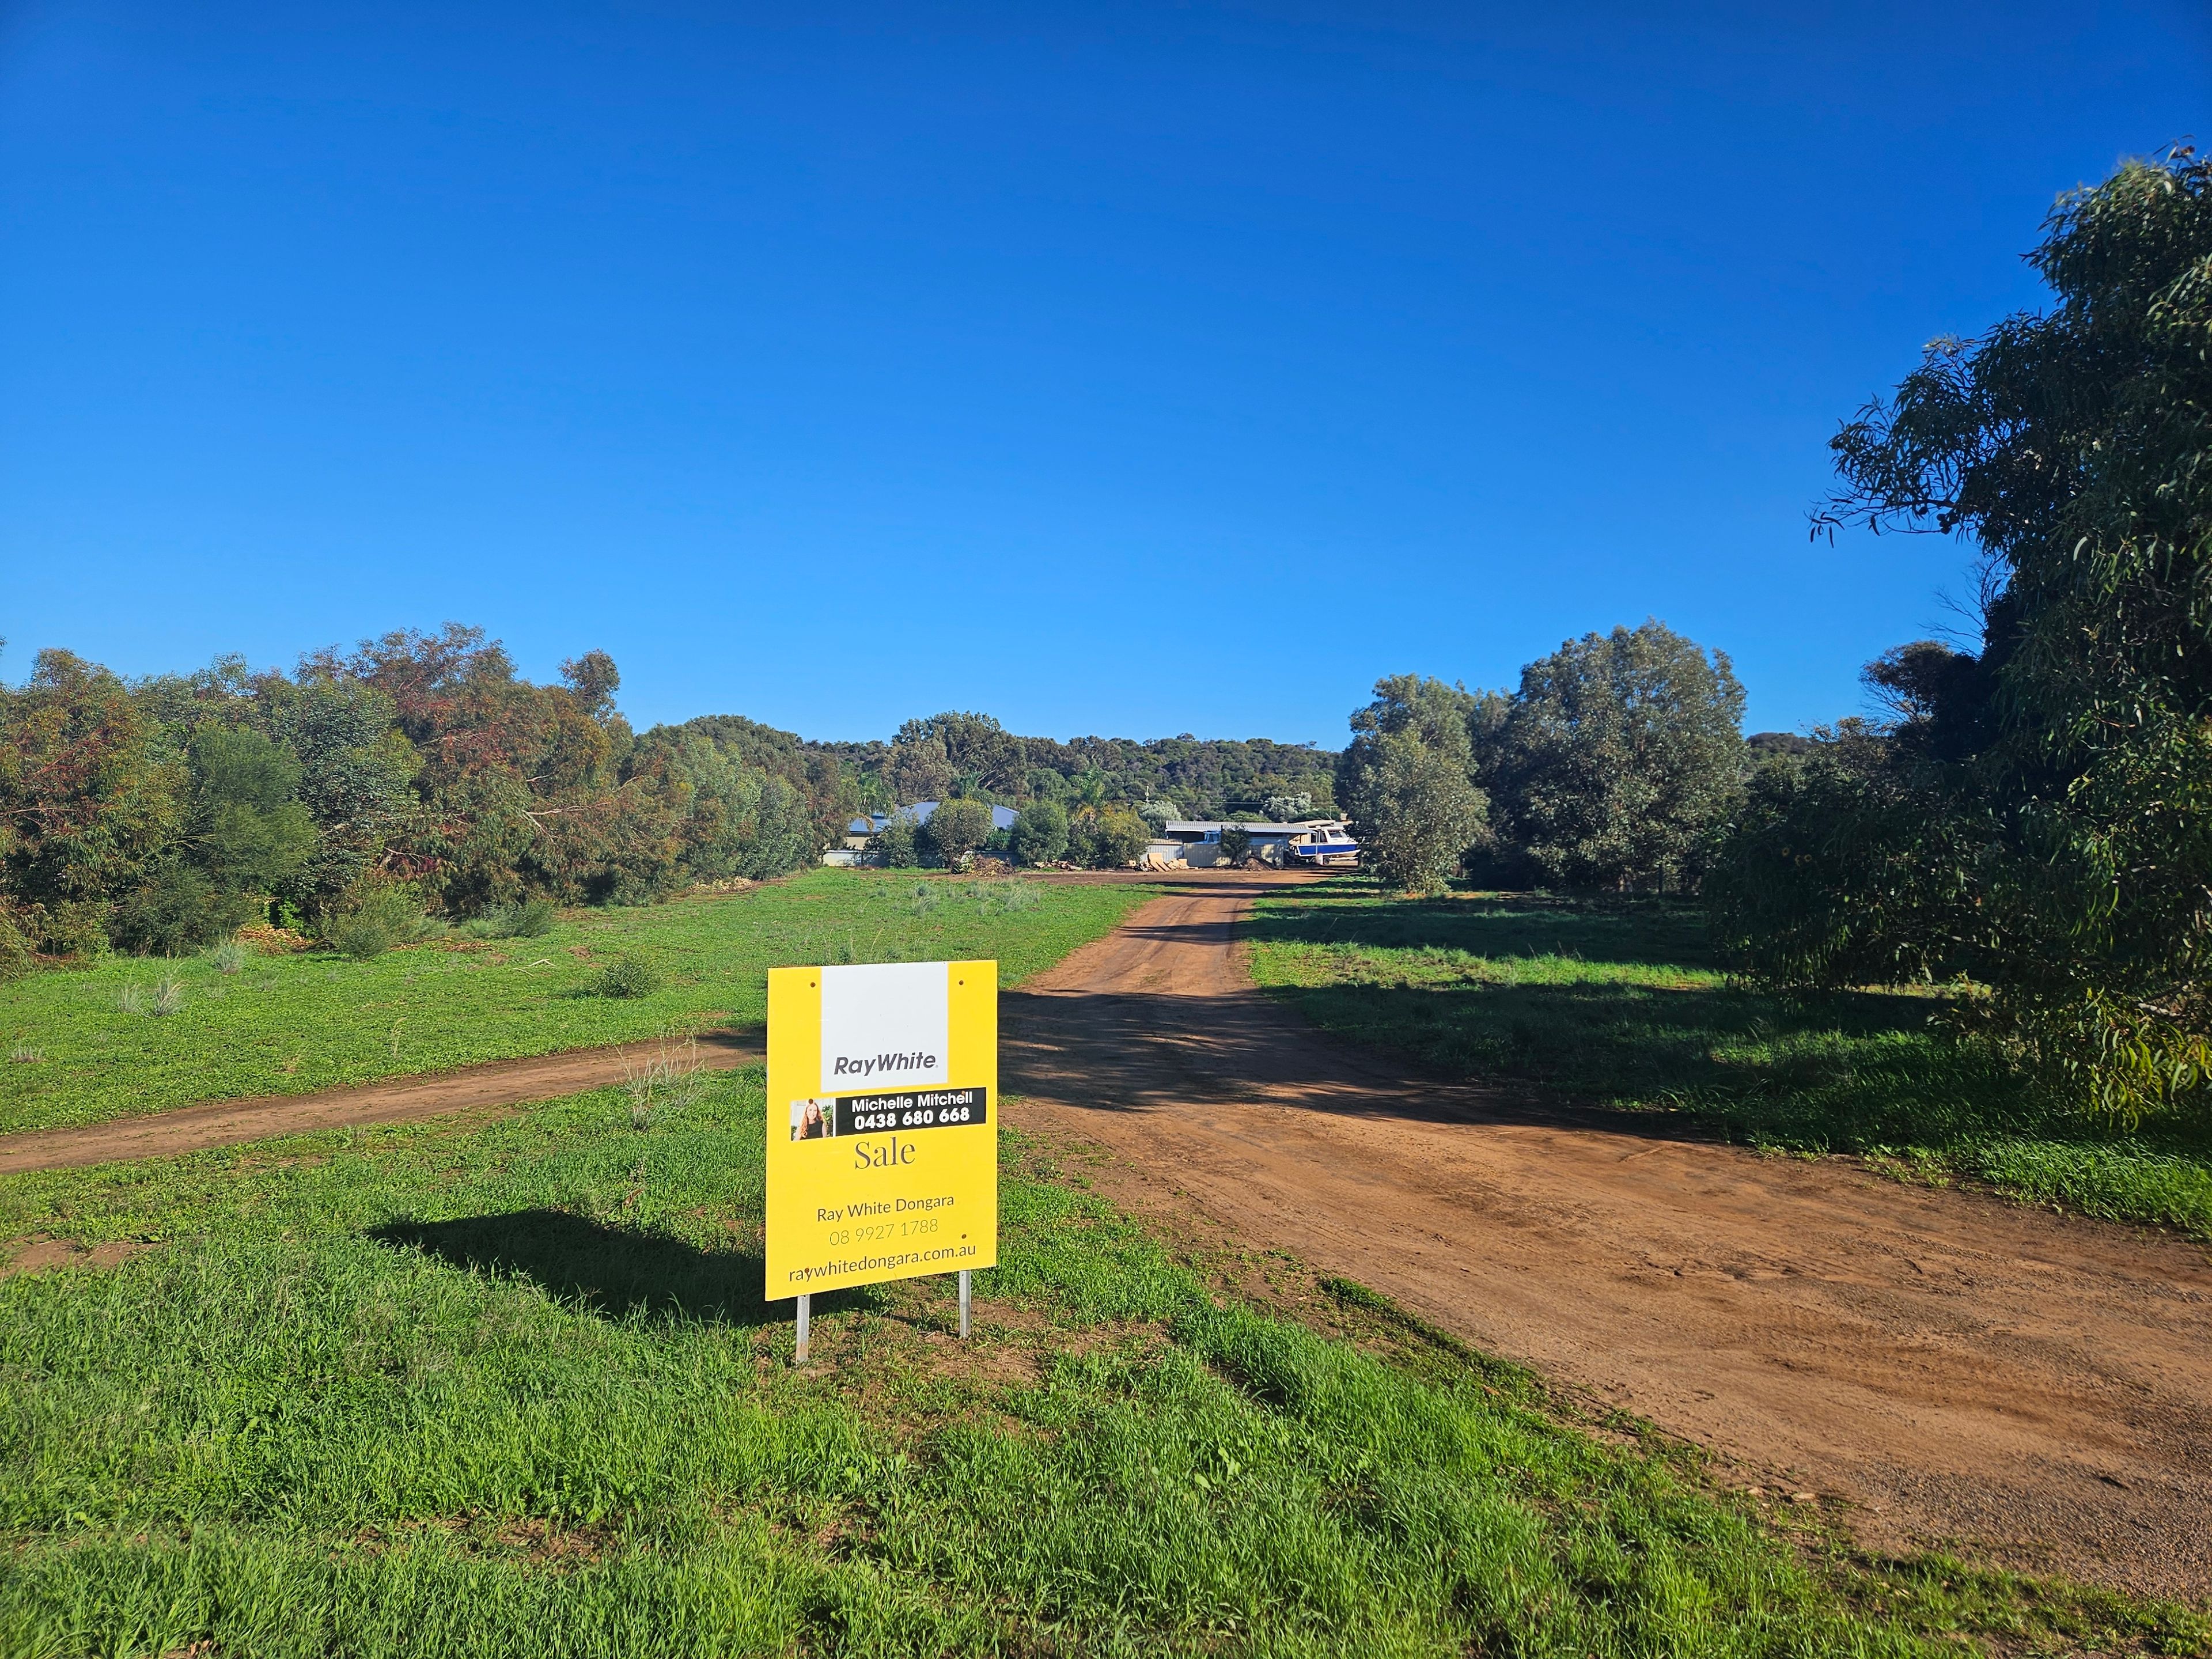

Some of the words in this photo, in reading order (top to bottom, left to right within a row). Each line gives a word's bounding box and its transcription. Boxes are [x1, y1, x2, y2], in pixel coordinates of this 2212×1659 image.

[852, 1097, 912, 1113] Michelle
[917, 1091, 972, 1107] Mitchell
[854, 1113, 897, 1130] 0438
[903, 1109, 934, 1126] 680
[938, 1107, 970, 1123] 668
[855, 1137, 915, 1171] Sale
[817, 1208, 843, 1224] Ray
[847, 1202, 891, 1217] White
[896, 1195, 954, 1211] Dongara
[830, 1230, 850, 1246] 08
[855, 1224, 893, 1241] 9927
[901, 1218, 938, 1236] 1788
[789, 1244, 976, 1282] raywhitedongara.com.au
